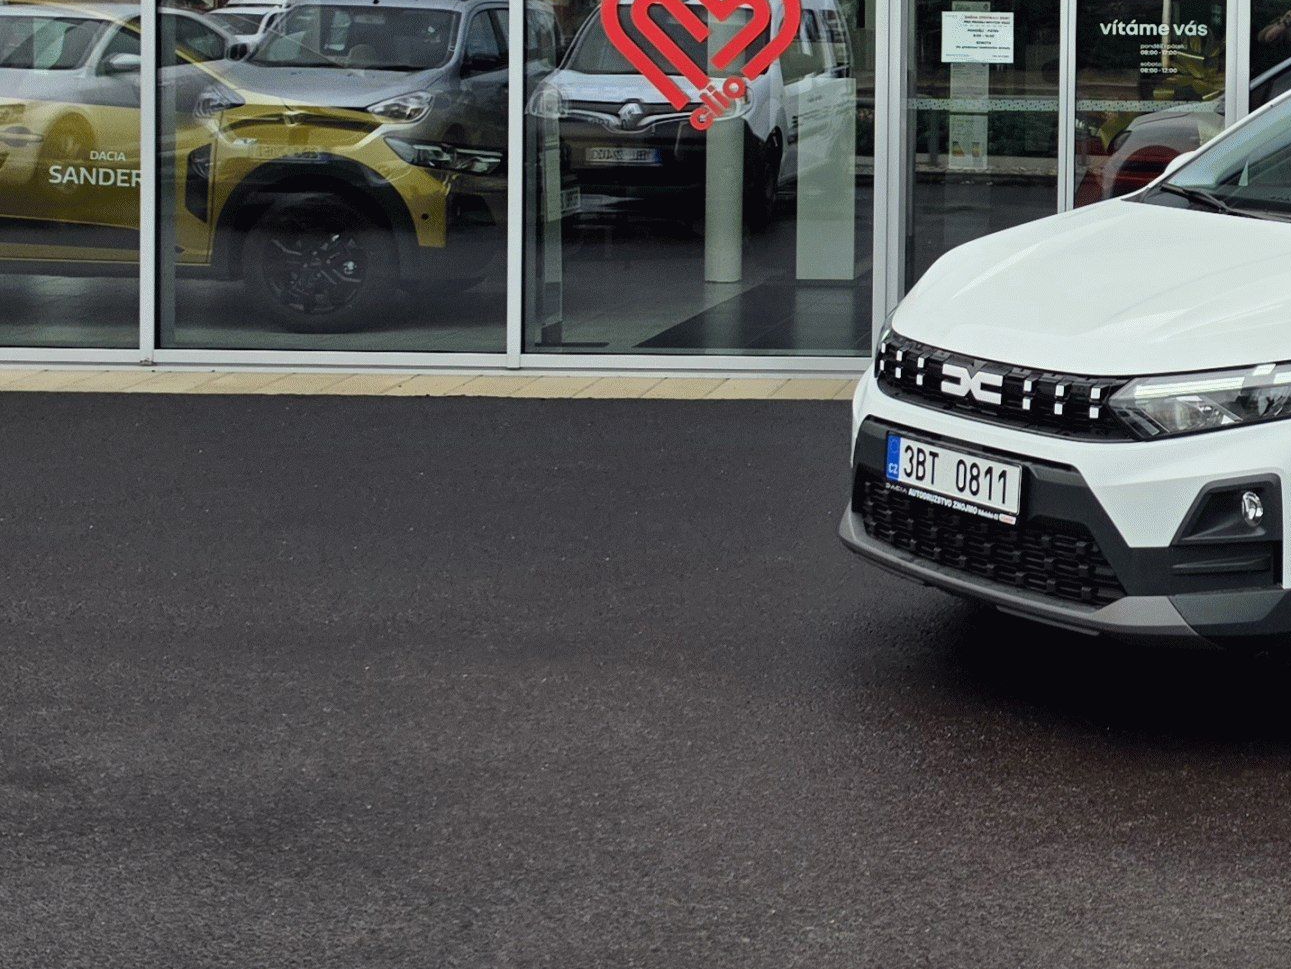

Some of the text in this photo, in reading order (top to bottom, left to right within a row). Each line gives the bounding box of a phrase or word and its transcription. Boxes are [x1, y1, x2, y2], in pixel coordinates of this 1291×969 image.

[1099, 19, 1208, 37] vítáme vás
[689, 75, 747, 131] clio
[89, 150, 127, 162] DACIA
[903, 444, 1007, 505] 3BT 0811
